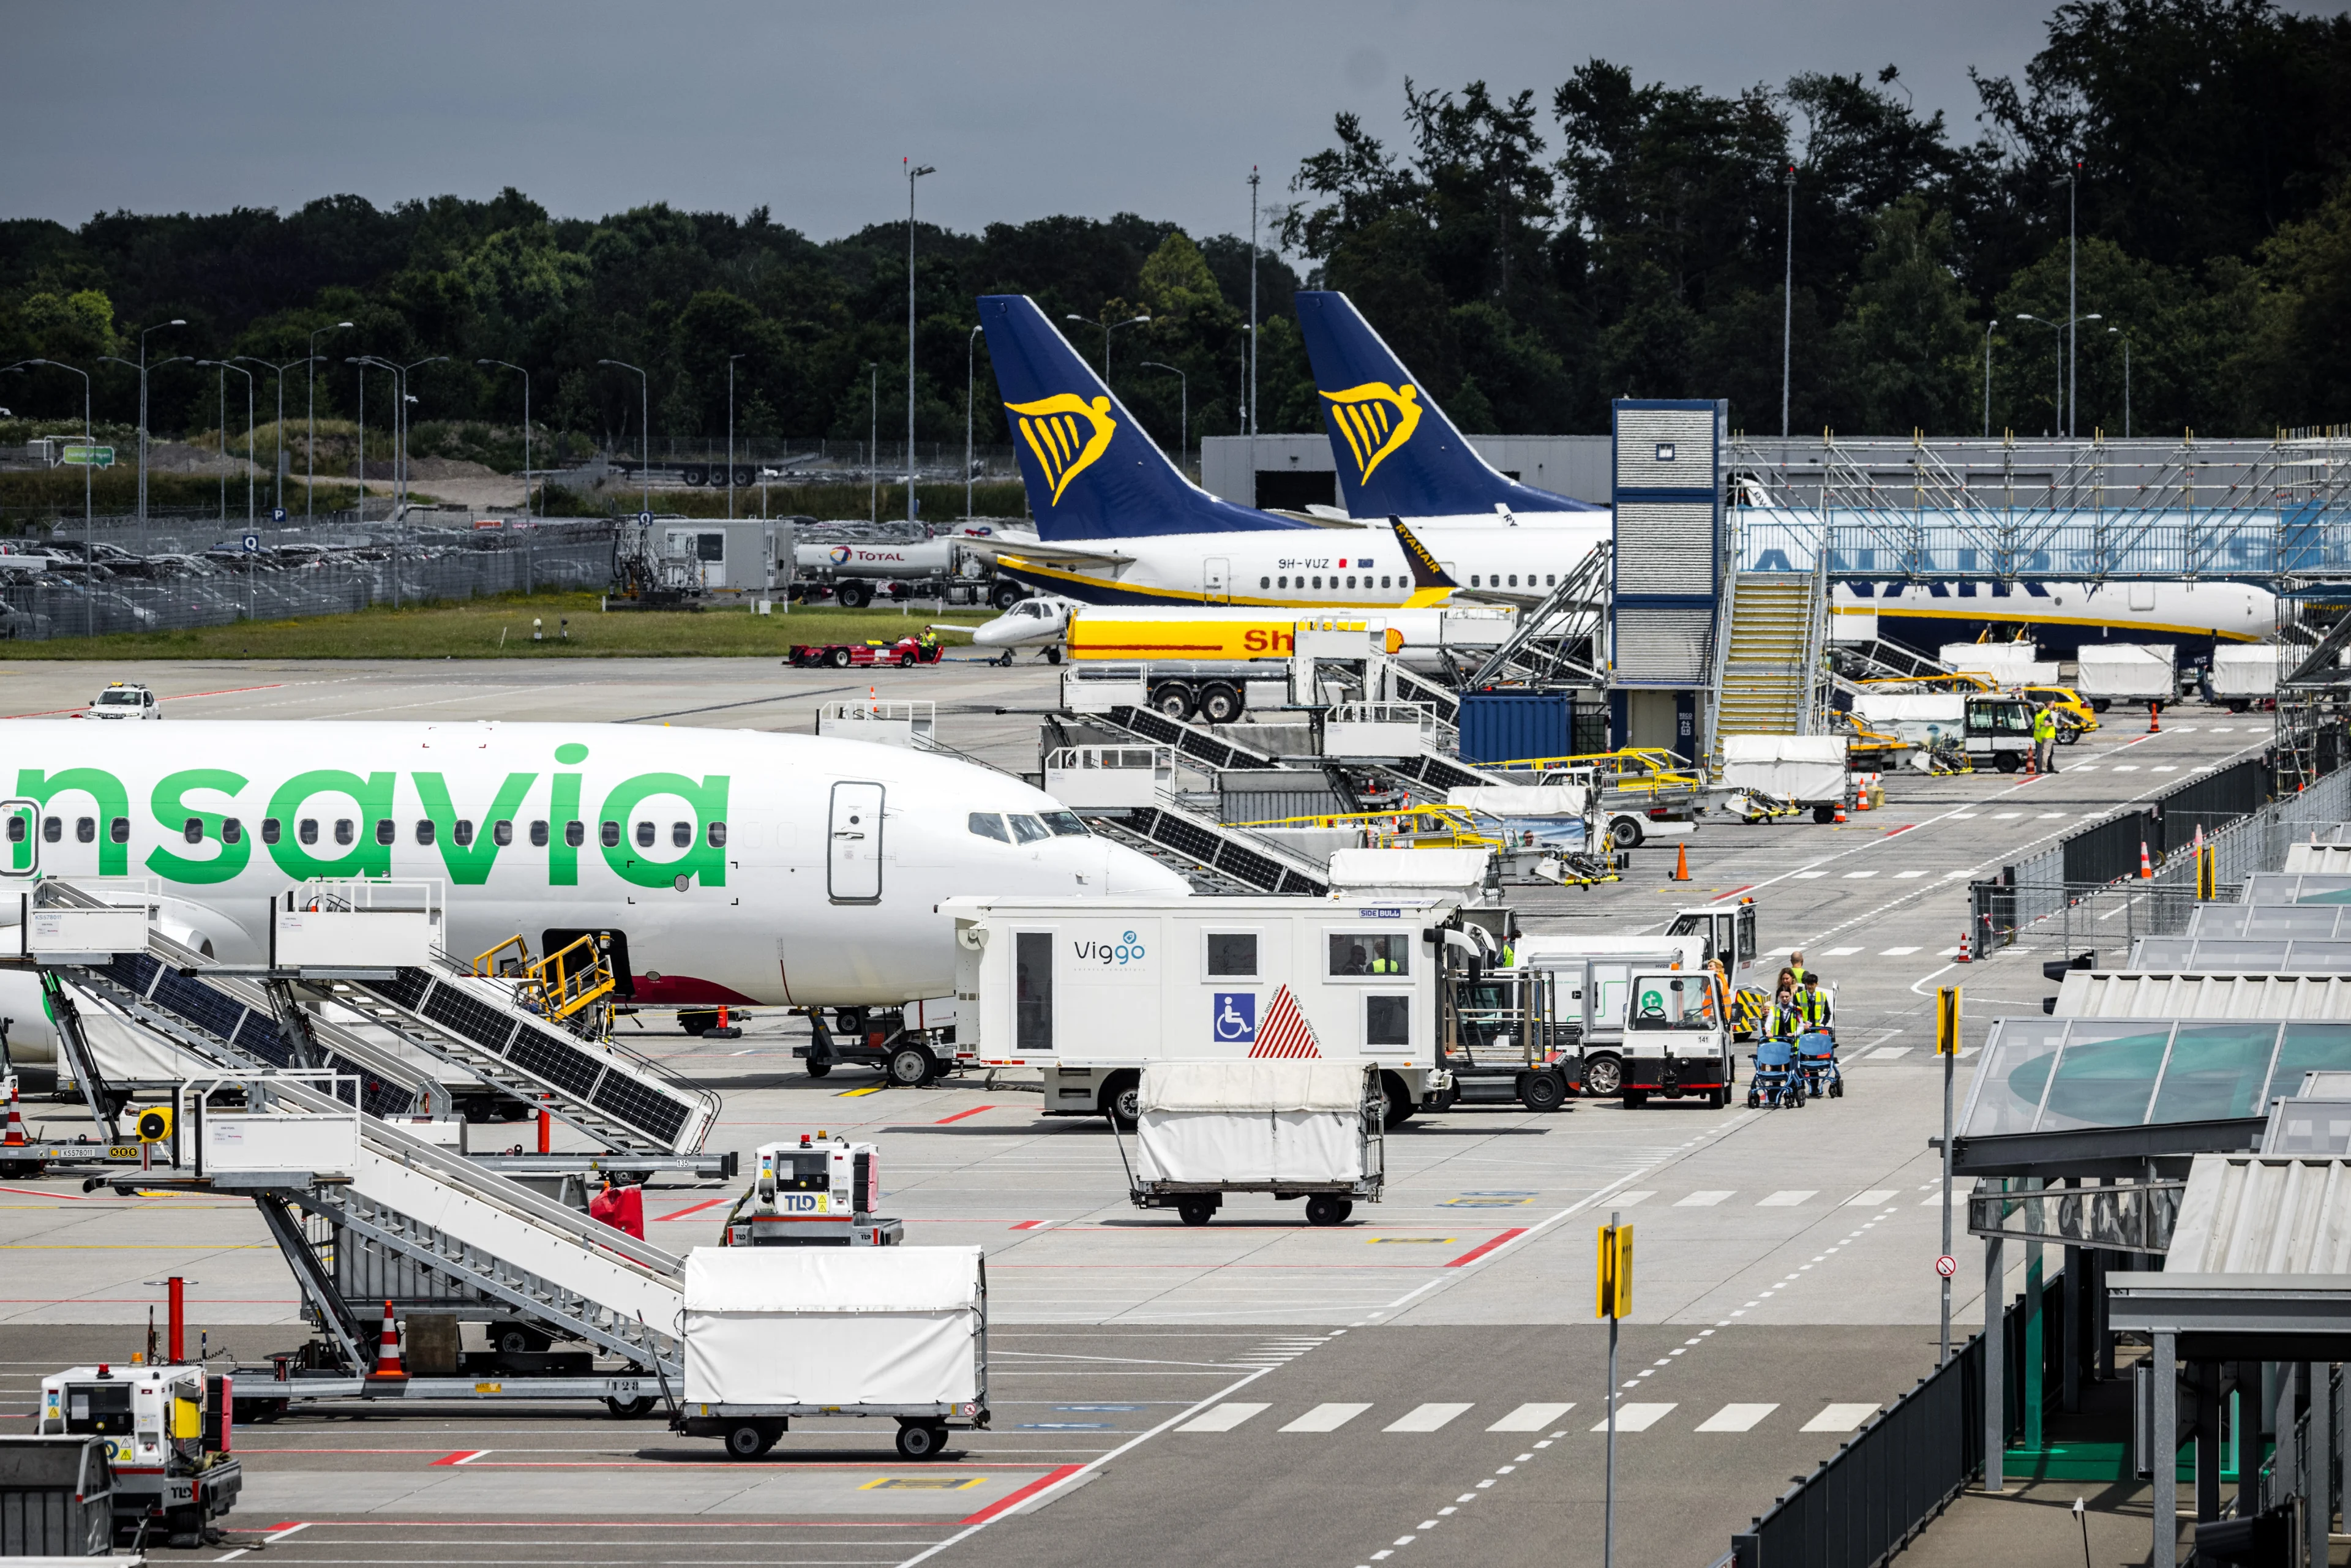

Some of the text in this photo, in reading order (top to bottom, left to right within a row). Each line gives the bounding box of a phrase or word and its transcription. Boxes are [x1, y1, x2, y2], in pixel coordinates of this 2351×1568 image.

[275, 510, 283, 520] P
[245, 536, 257, 550] Q
[1395, 523, 1441, 574] RYANAIR
[857, 550, 905, 561] TOTAL
[1278, 558, 1330, 569] 9H-VUZ
[1074, 941, 1145, 965] Viggo
[1264, 1000, 1274, 1014] DODE
[1270, 986, 1281, 1001] HOEK!
[1305, 1018, 1314, 1032] DODE
[1311, 1031, 1321, 1046] HOEK!
[784, 1195, 816, 1211] TLD
